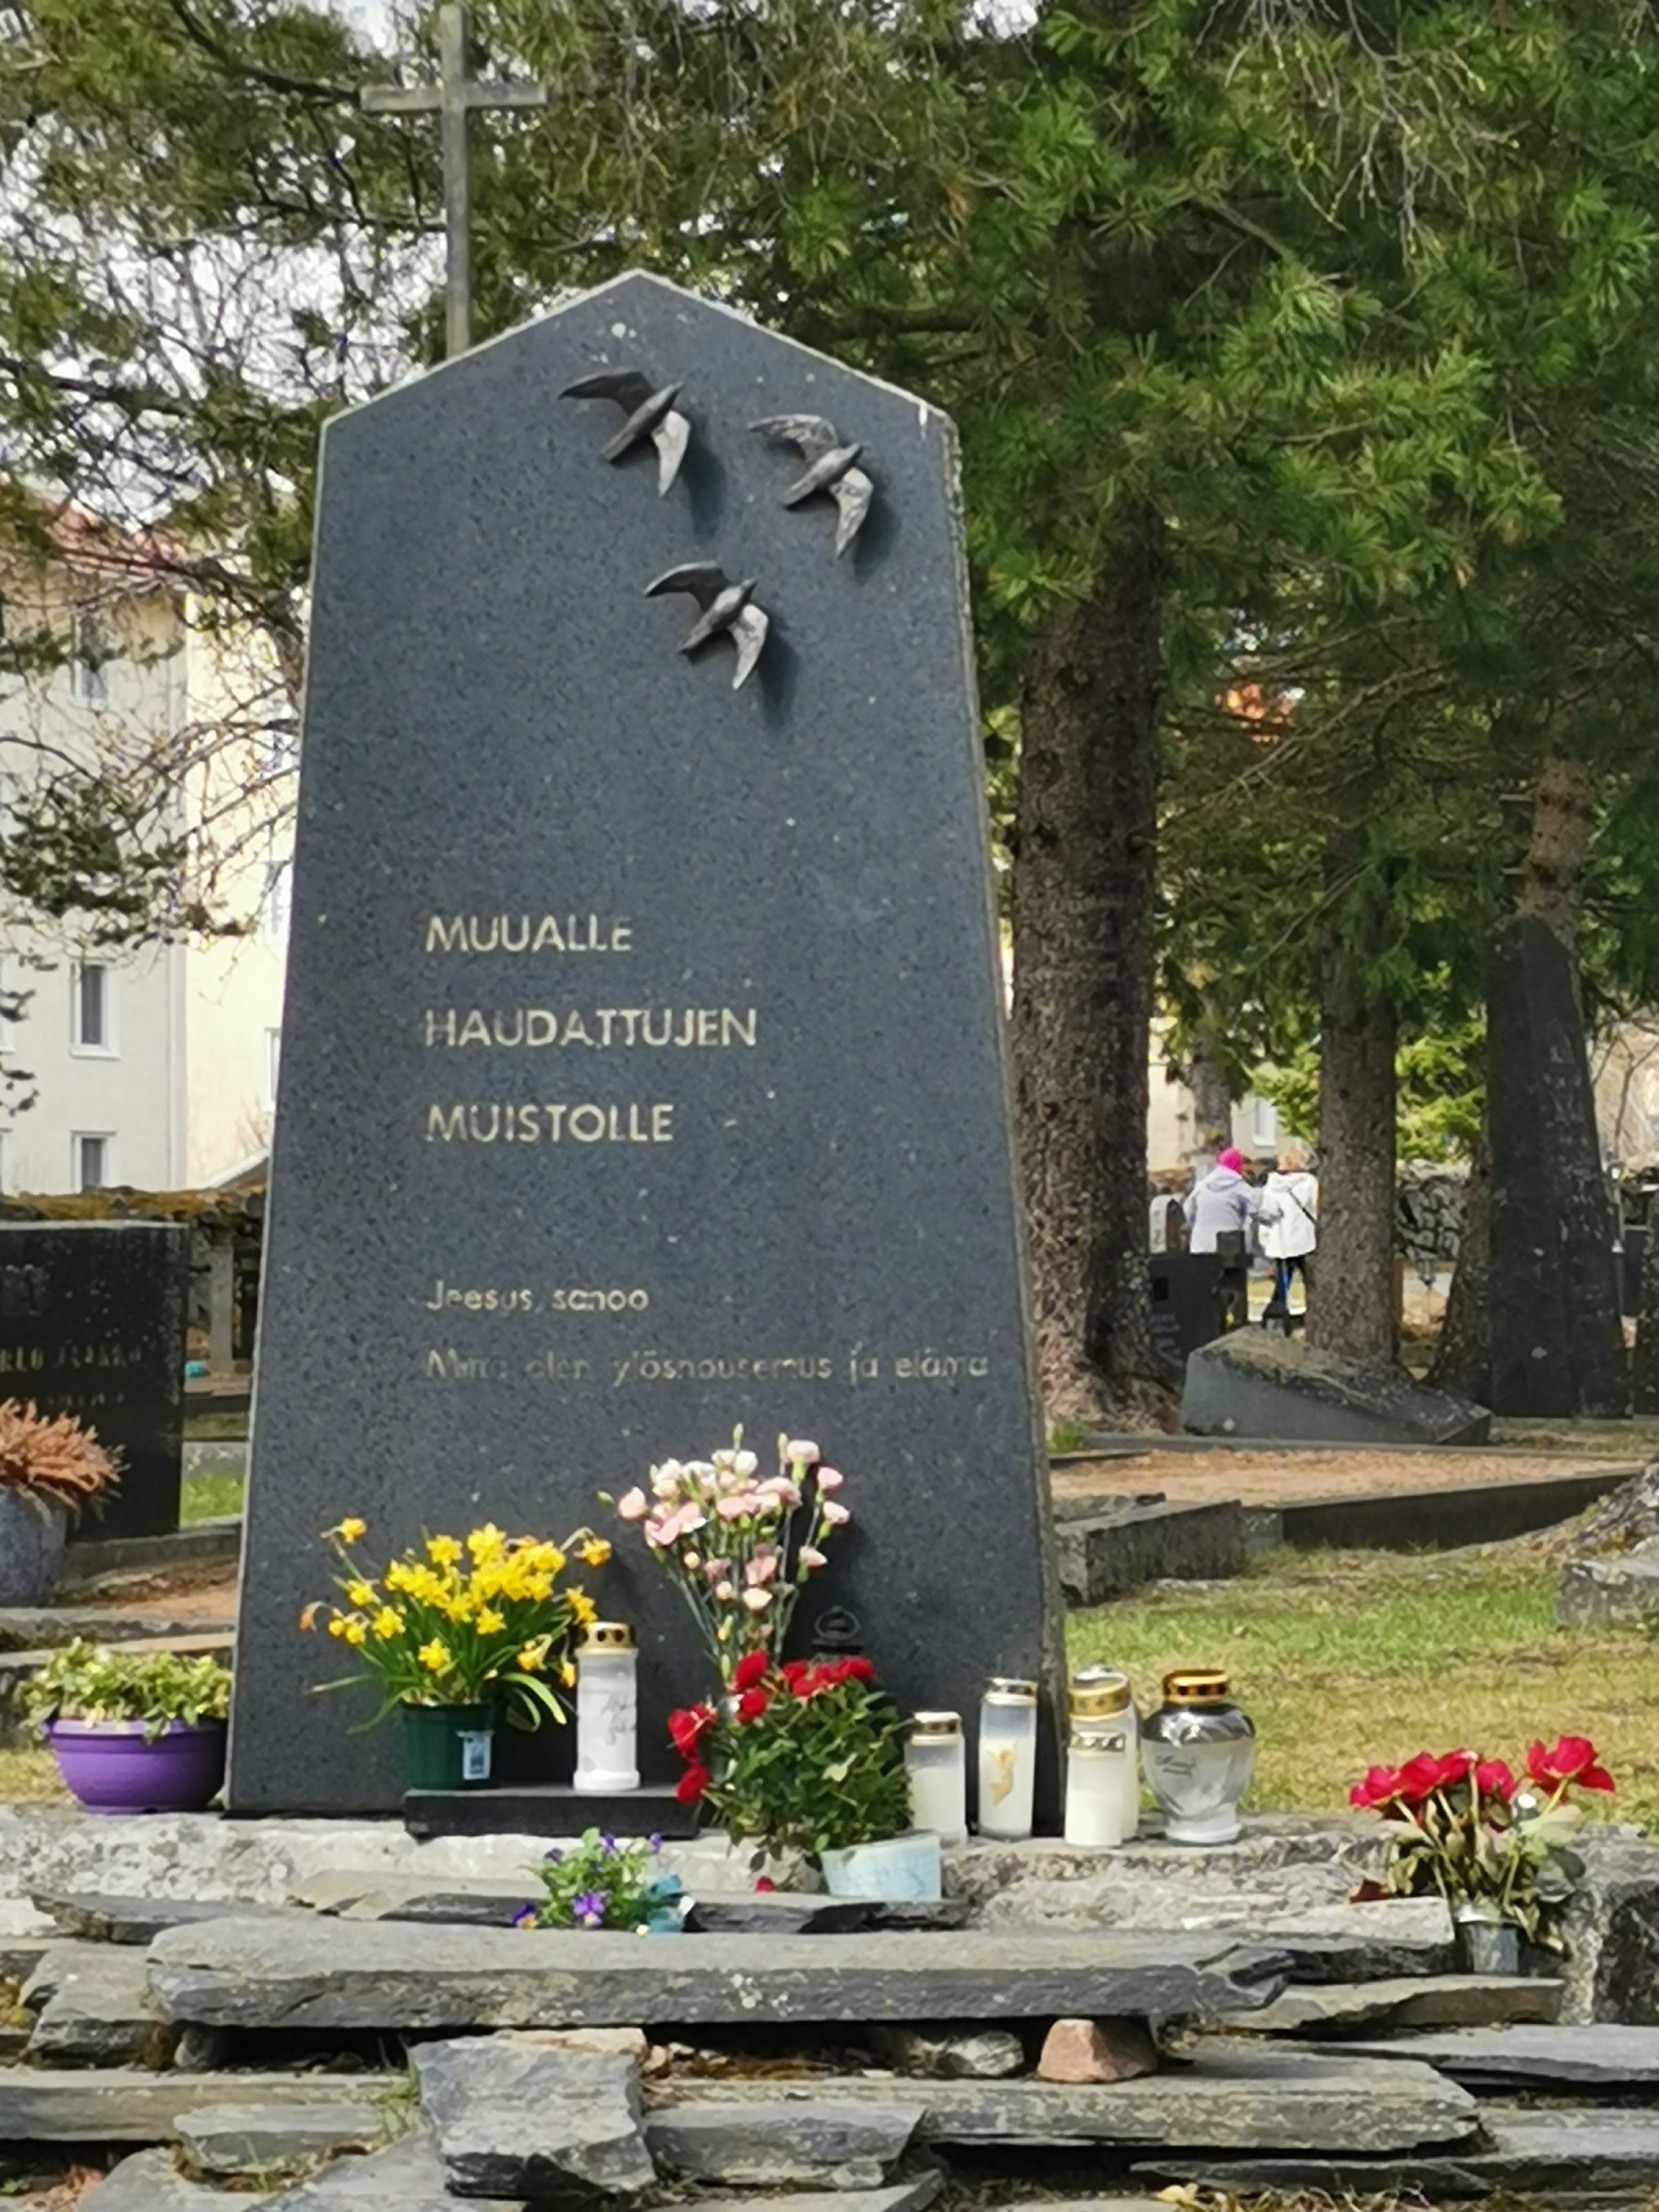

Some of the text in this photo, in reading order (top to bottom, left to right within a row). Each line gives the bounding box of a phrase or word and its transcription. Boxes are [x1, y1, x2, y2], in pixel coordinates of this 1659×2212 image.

[426, 915, 632, 952] MUUALLE
[425, 1009, 757, 1047] HAUDATTUJEN
[426, 1103, 674, 1141] MUISTOLLE
[426, 1279, 649, 1311] Jeesus sanoo
[613, 1349, 834, 1387] yösnousemus
[850, 1349, 879, 1386] ja
